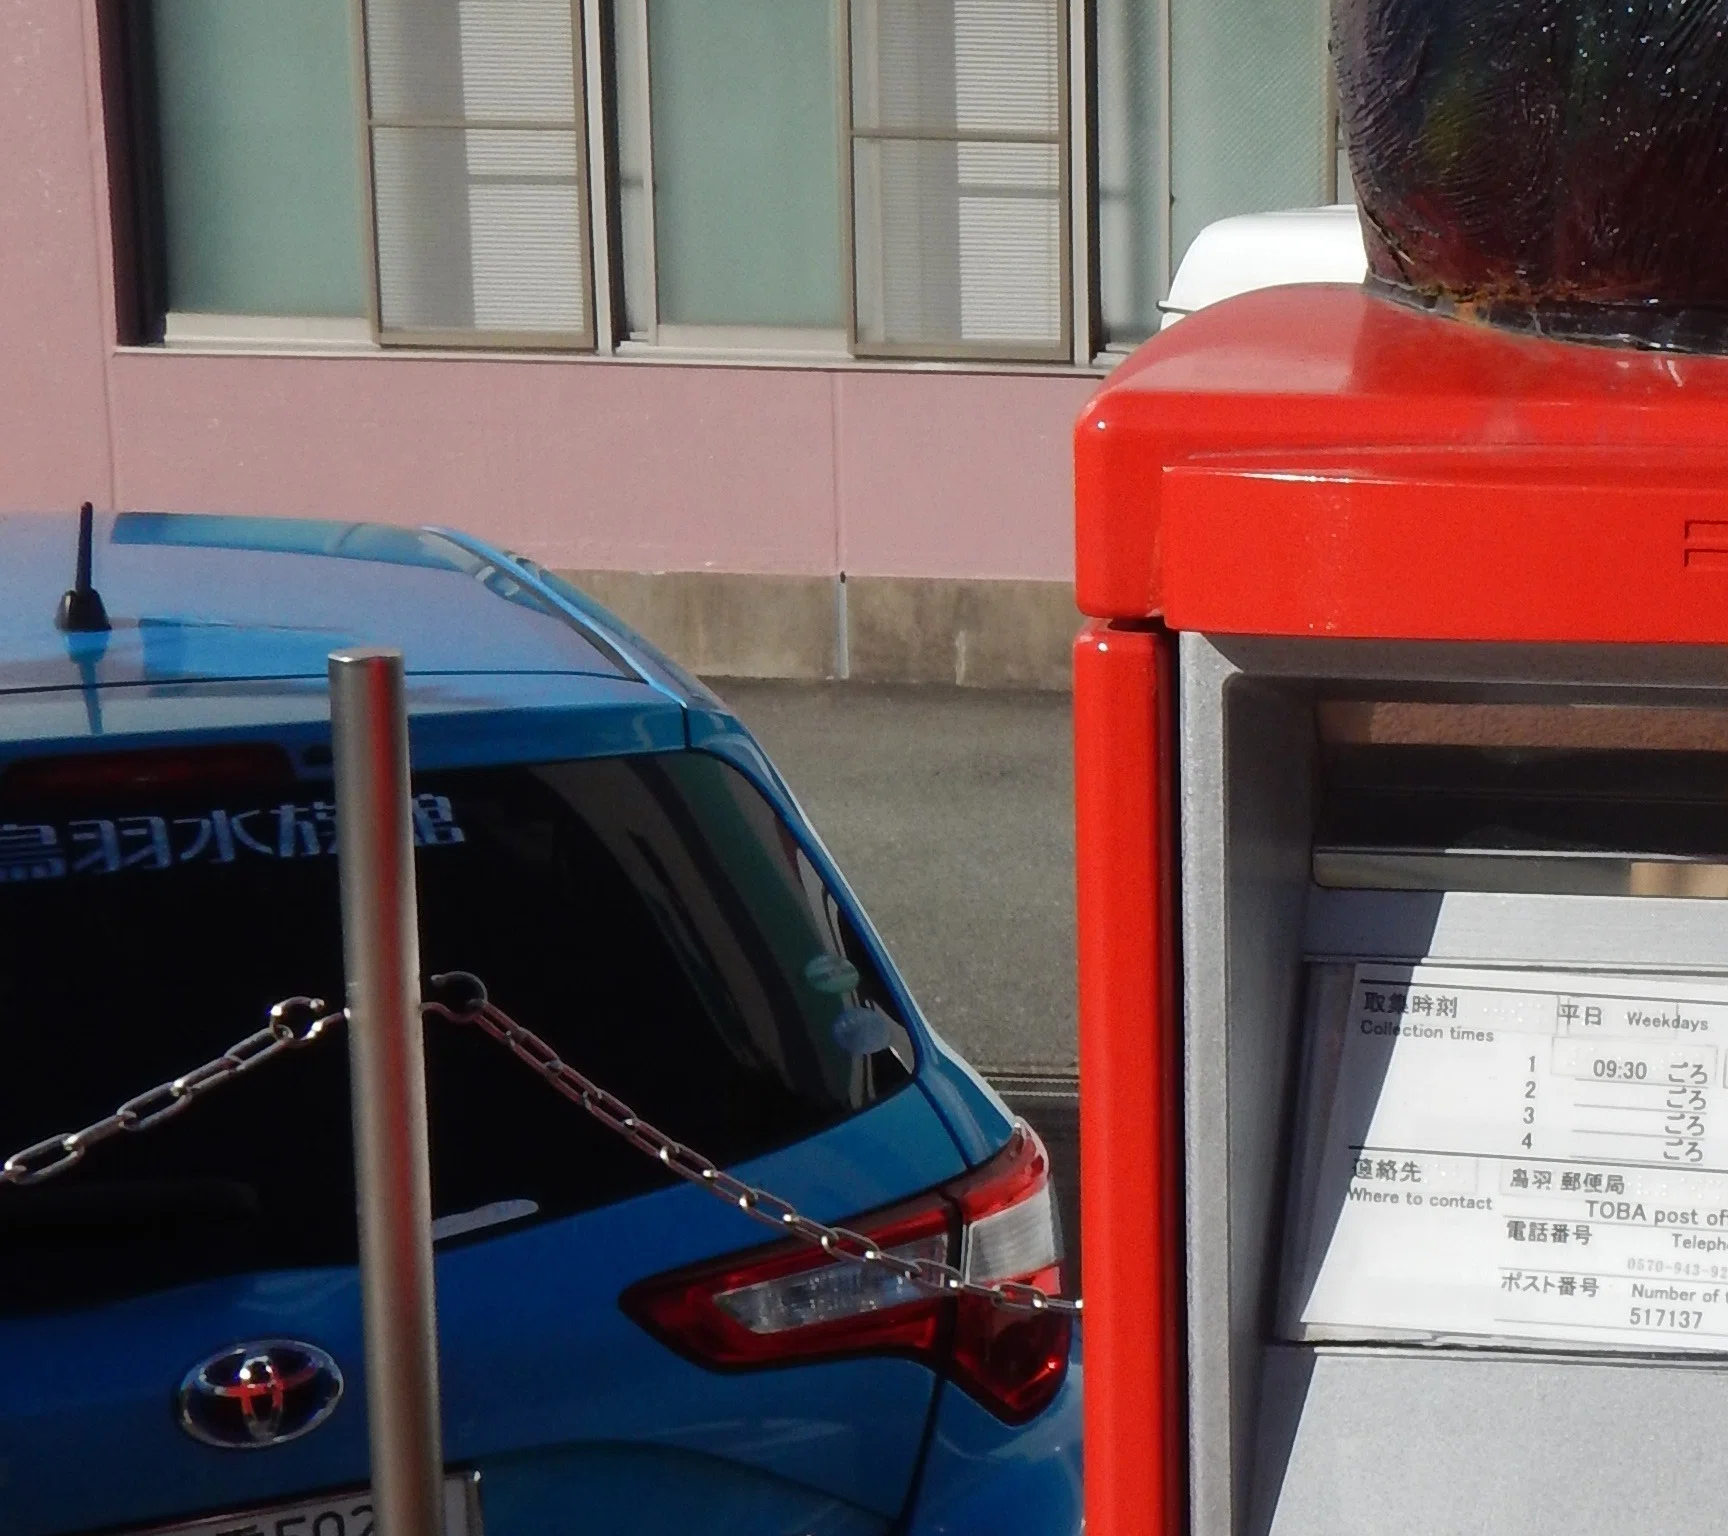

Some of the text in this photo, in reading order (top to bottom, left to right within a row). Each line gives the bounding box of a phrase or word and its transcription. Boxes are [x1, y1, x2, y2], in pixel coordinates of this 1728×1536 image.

[1364, 992, 1458, 1018] 取集時刻
[1559, 1004, 1709, 1032] 平日 Weekdays
[1360, 1019, 1495, 1043] Collection times
[1528, 1055, 1536, 1072] 1
[1593, 1060, 1648, 1080] 09:30
[1668, 1061, 1709, 1085] ごろ
[1525, 1081, 1536, 1098] 2
[1666, 1087, 1707, 1111] ごろ
[1523, 1107, 1534, 1124] 3
[1665, 1113, 1705, 1137] ごろ
[1521, 1132, 1532, 1149] 4
[1663, 1139, 1703, 1162] ごろ
[1353, 1158, 1422, 1183] 連絡先
[1561, 1171, 1624, 1195] 郵便局
[1350, 1187, 1493, 1210] Where to contact
[1586, 1200, 1647, 1221] TOBA
[1654, 1207, 1701, 1227] post
[1507, 1220, 1593, 1246] 電話番号
[1501, 1273, 1600, 1297] ポスト番号
[1631, 1284, 1697, 1301] Number
[1702, 1289, 1720, 1303] of
[1629, 1306, 1703, 1329] 517137
